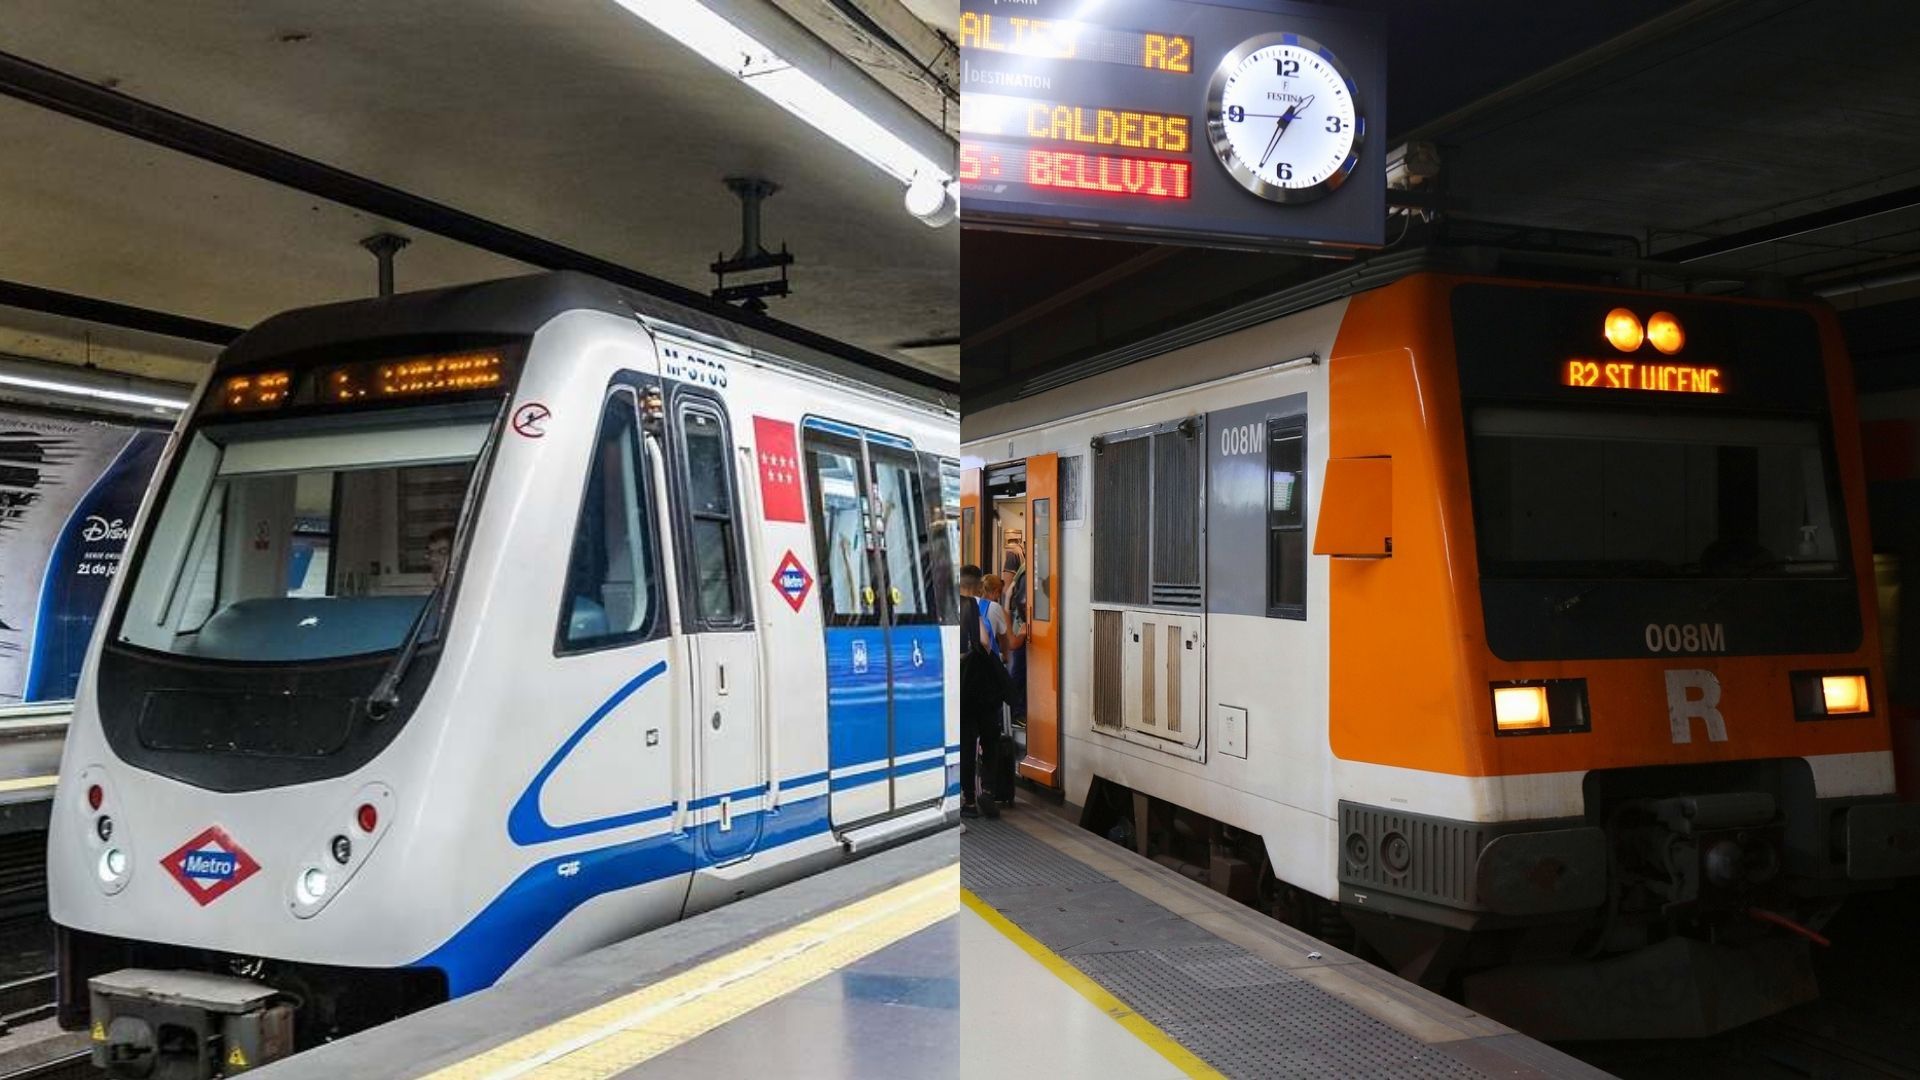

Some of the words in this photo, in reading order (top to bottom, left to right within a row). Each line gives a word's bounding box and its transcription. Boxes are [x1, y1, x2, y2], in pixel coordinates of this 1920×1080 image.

[1145, 33, 1188, 72] R2
[1273, 58, 1300, 78] 12
[971, 69, 1051, 89] DESTINATION
[1266, 91, 1304, 103] FESTINA
[1228, 105, 1245, 123] 9
[1027, 103, 1189, 152] CALDERS
[1325, 116, 1341, 133] 3
[1028, 150, 1188, 198] BELLVIT
[1276, 162, 1293, 180] 6
[1221, 422, 1263, 456] 008M
[1645, 623, 1725, 653] 008M
[1664, 669, 1728, 744] R
[186, 855, 232, 875] Metro
